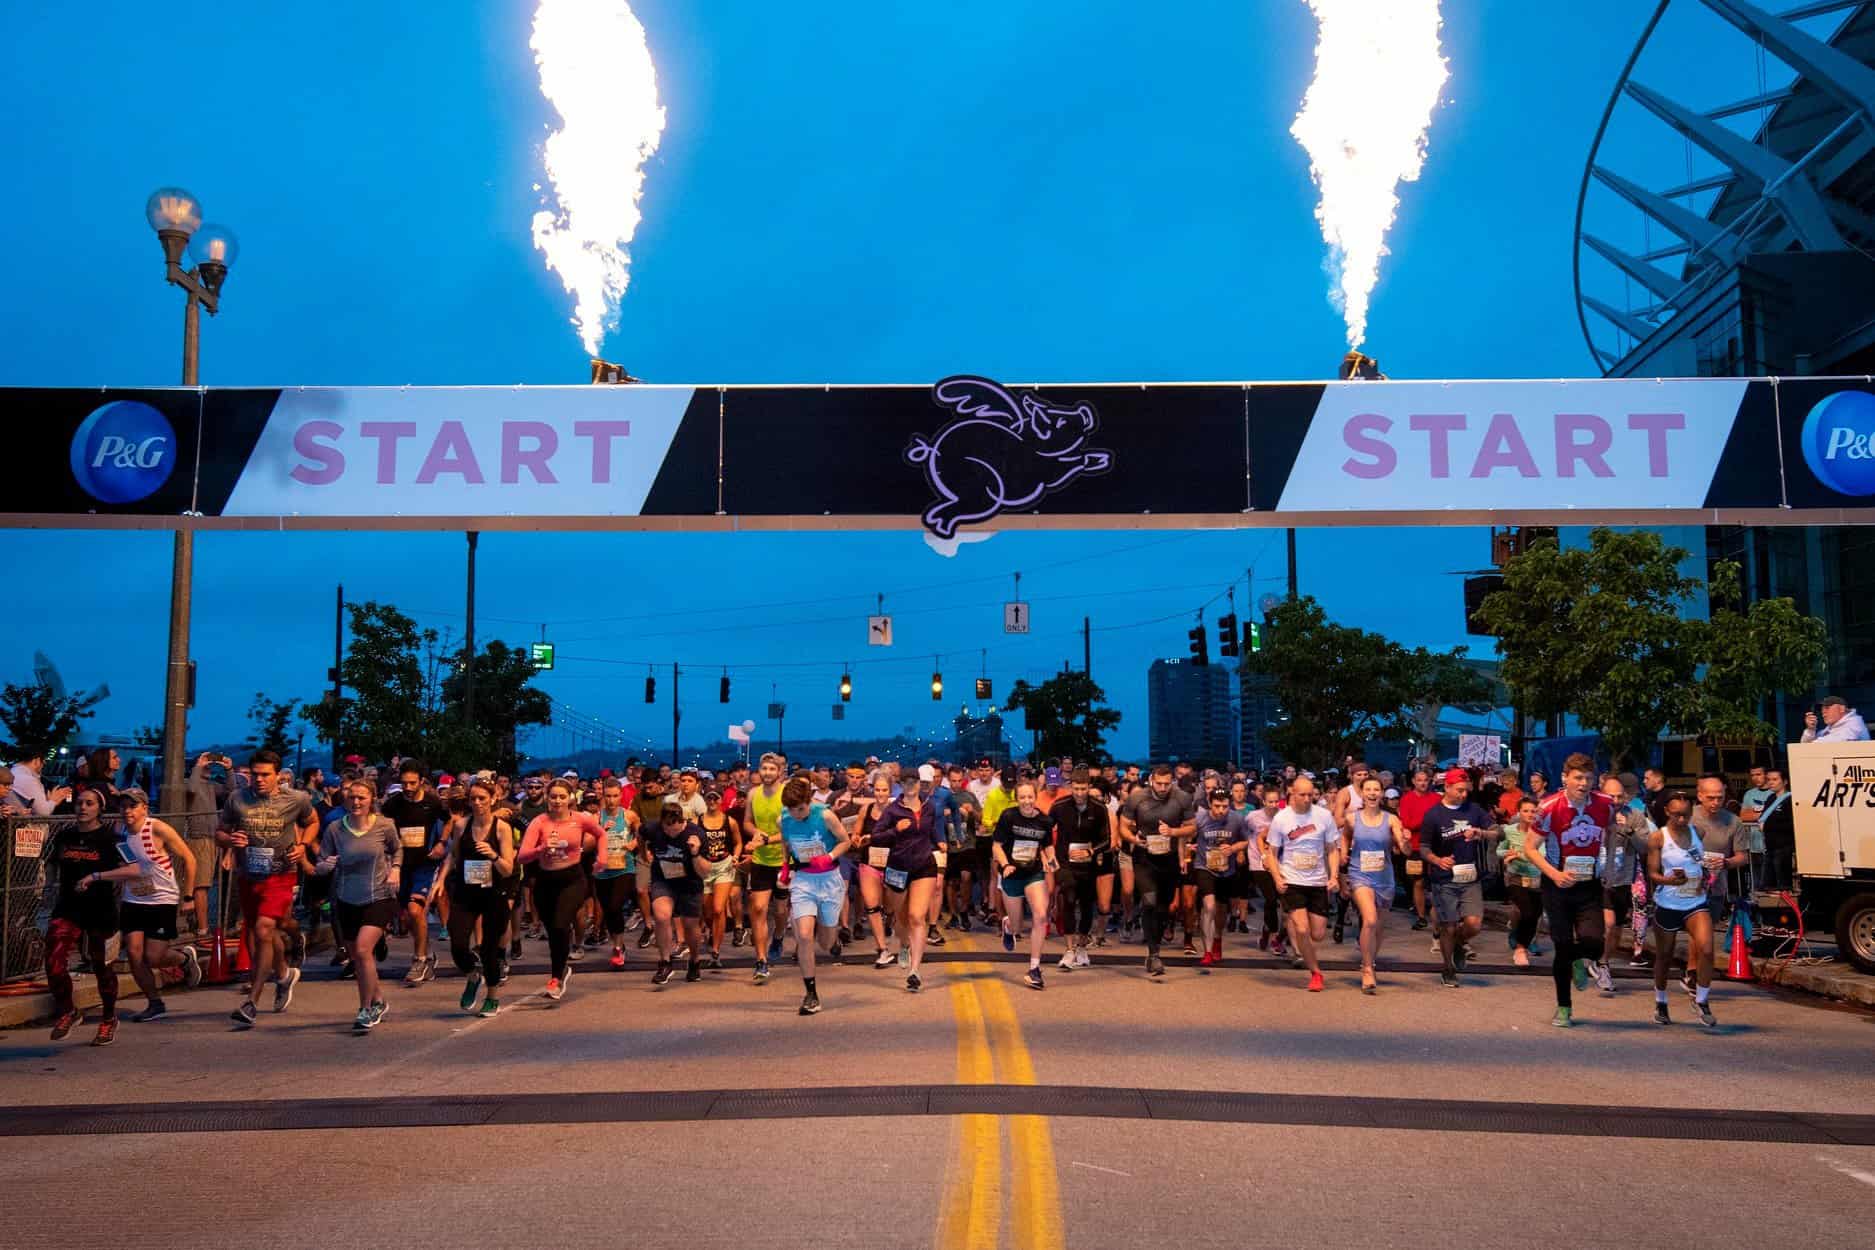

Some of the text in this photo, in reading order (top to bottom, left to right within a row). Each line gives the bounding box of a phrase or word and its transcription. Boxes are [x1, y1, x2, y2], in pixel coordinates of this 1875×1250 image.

[92, 436, 167, 468] P&G
[289, 419, 631, 485] START
[1341, 413, 1686, 480] START
[1824, 427, 1875, 460] P&
[1007, 624, 1026, 632] ONLY
